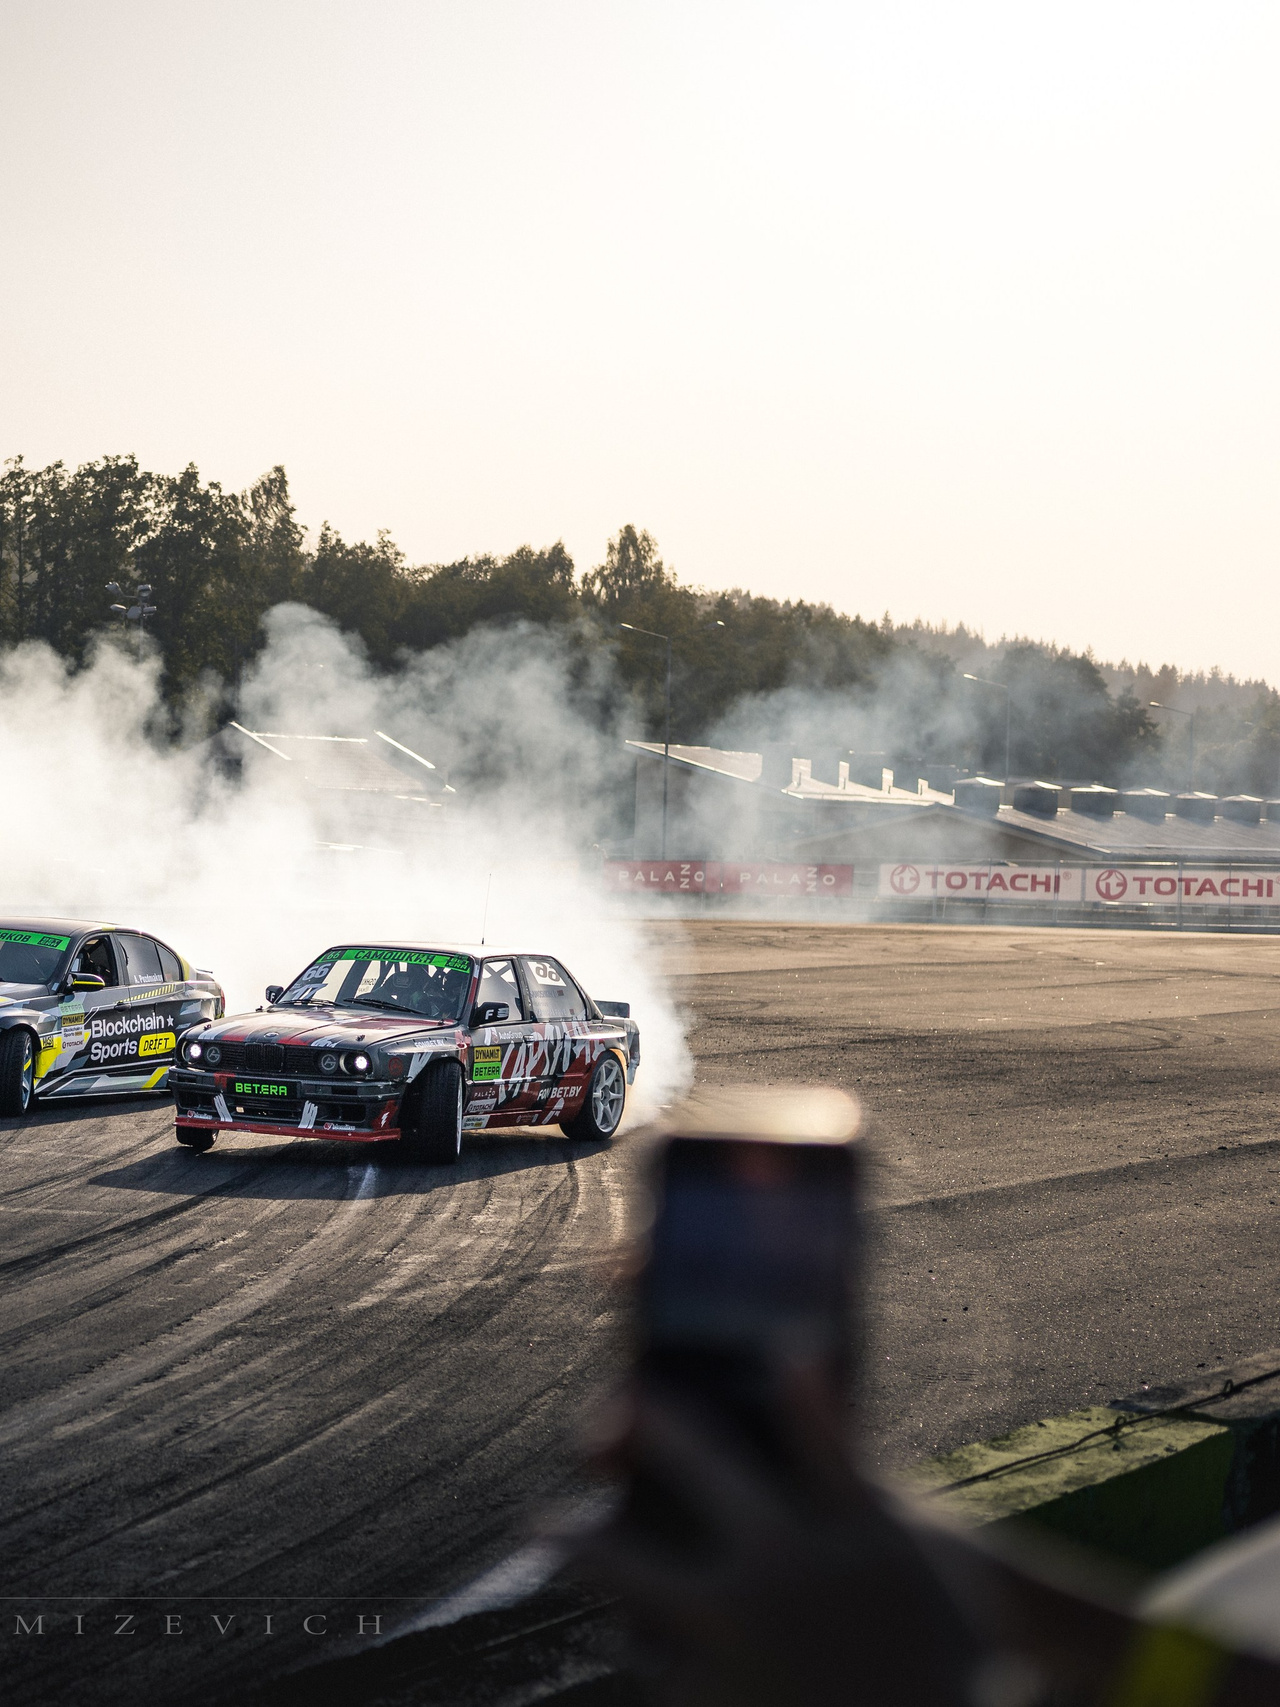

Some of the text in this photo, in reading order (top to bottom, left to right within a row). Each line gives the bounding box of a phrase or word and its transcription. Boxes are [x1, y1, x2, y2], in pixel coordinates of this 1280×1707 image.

[925, 871, 1060, 894] TOTACHI
[1133, 877, 1273, 898] TOTACHI
[354, 950, 436, 964] САМОШКИН
[302, 963, 332, 981] 66
[91, 1012, 165, 1038] Blockchain
[90, 1038, 170, 1063] Sports DRIFT
